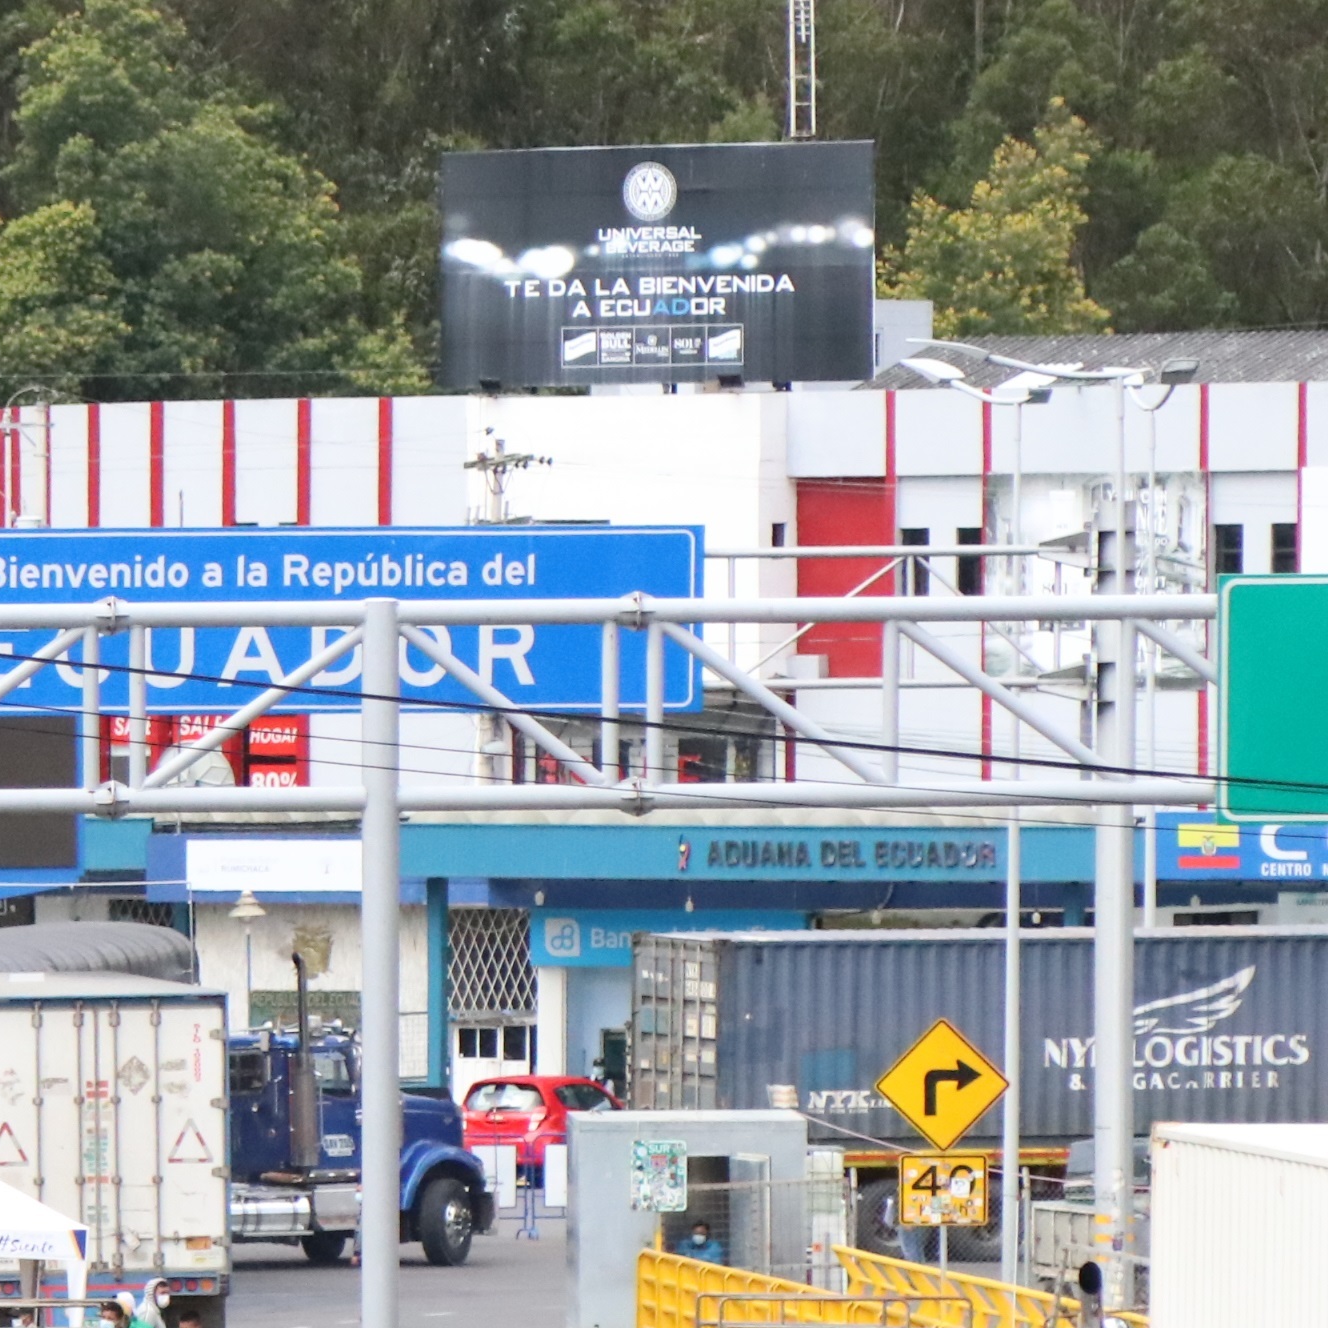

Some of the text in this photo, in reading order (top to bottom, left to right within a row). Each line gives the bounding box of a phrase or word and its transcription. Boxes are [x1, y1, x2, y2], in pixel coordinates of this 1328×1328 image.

[598, 226, 702, 241] UNIVERSAL
[605, 240, 695, 253] BEVERAGE
[504, 274, 795, 297] TE DA LA BIENVENIDA
[572, 297, 726, 317] A ECUADOR
[202, 564, 223, 588] a
[237, 556, 268, 588] la
[283, 553, 467, 594] República
[482, 553, 535, 586] del
[707, 840, 997, 870] ADUANA DEL ECUADOR
[1260, 862, 1312, 877] CENTRO
[808, 1090, 871, 1109] NYK
